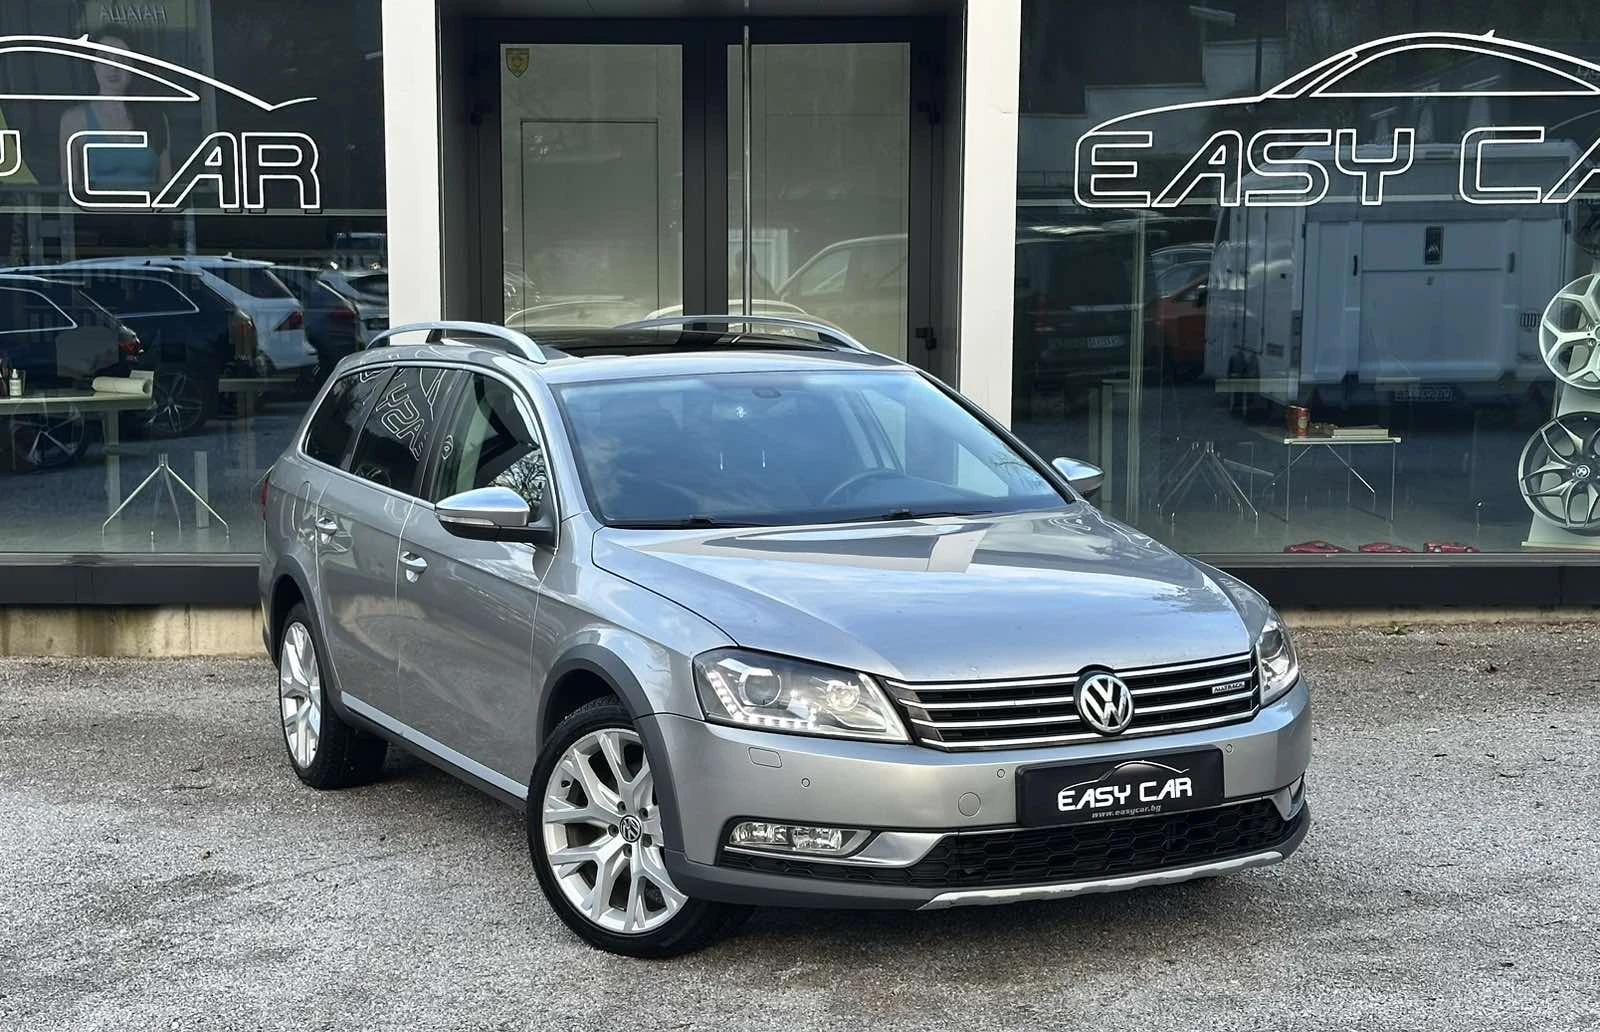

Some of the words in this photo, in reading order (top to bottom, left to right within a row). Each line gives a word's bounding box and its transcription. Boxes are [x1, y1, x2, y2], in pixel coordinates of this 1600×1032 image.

[67, 131, 321, 209] CAR
[1074, 127, 1415, 207] EASY
[1058, 784, 1131, 811] EASY
[1139, 777, 1193, 802] CAR
[1091, 805, 1161, 818] www.easycar.bg
